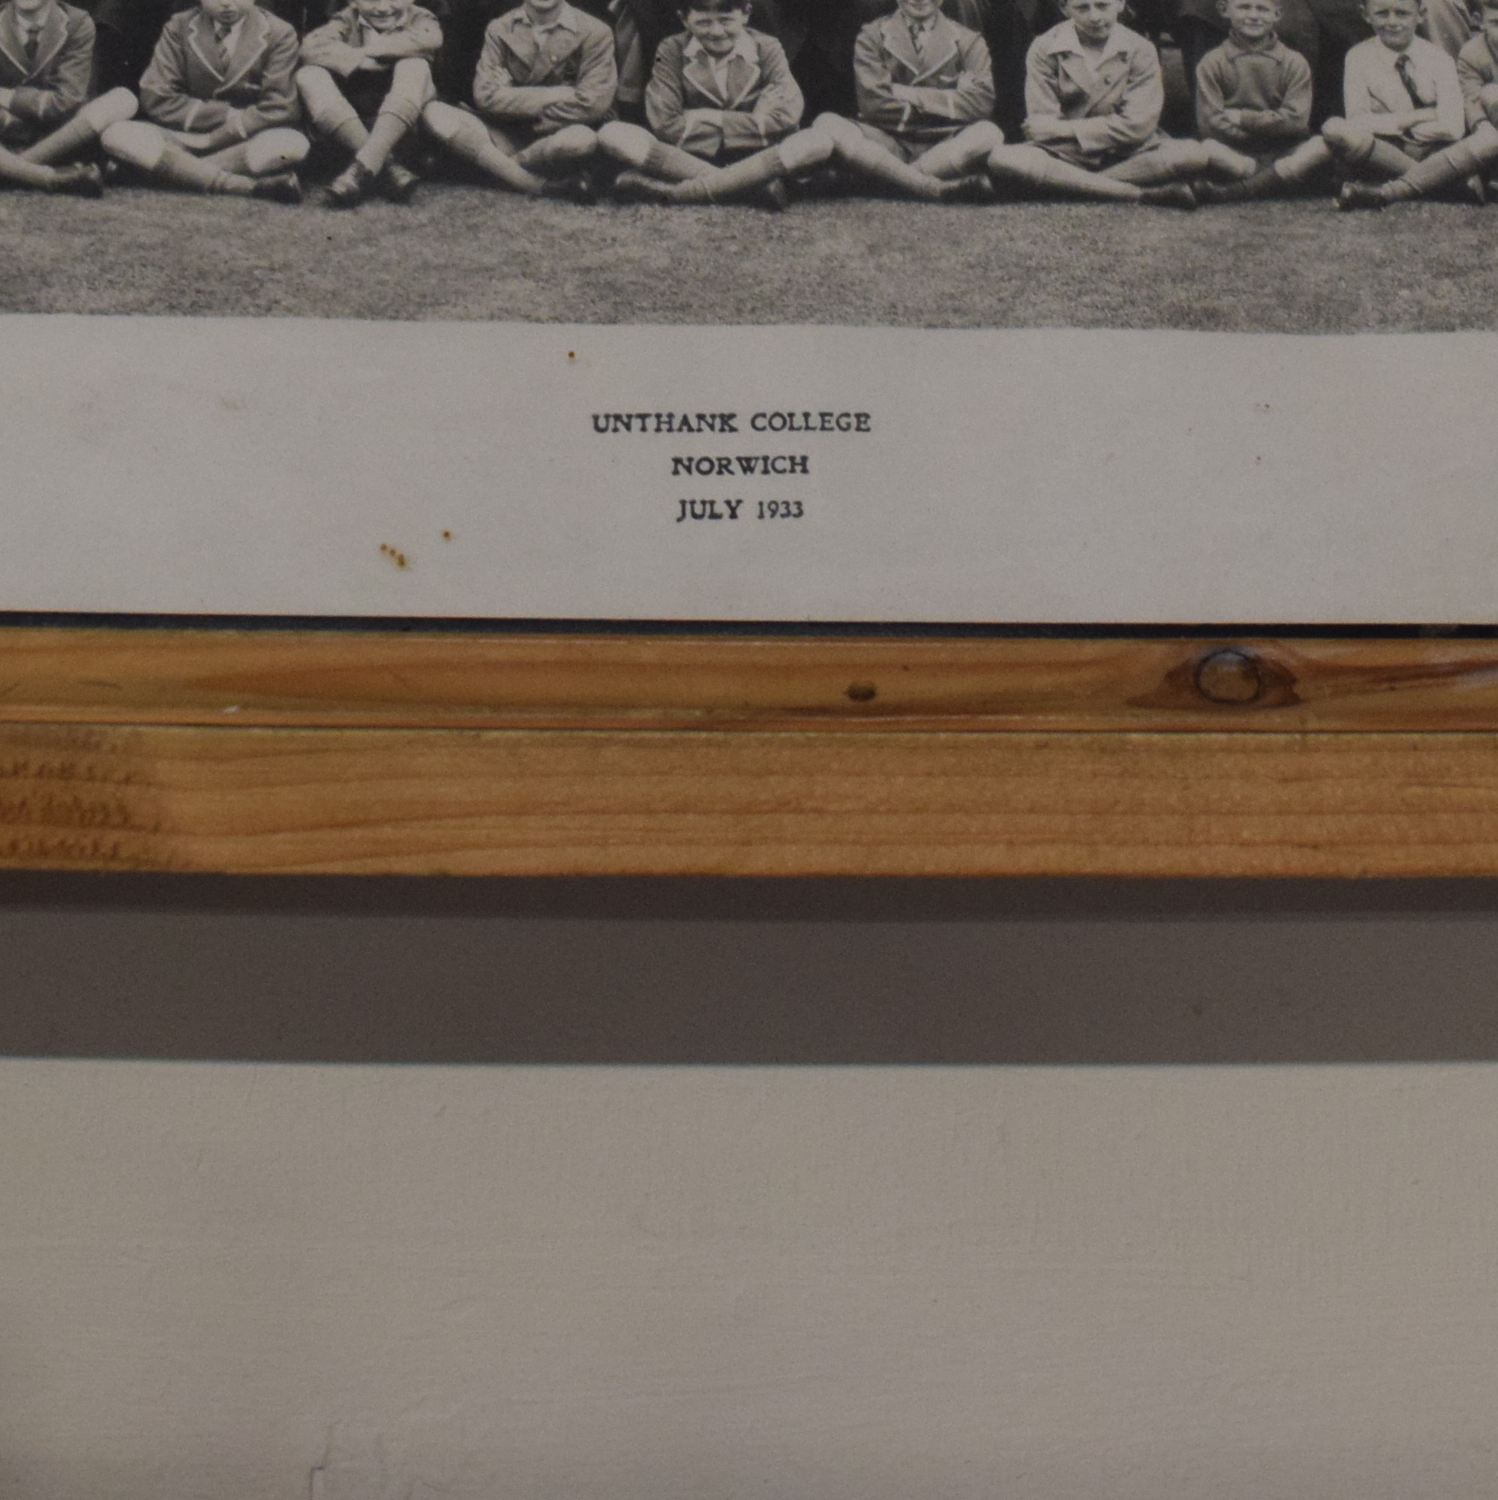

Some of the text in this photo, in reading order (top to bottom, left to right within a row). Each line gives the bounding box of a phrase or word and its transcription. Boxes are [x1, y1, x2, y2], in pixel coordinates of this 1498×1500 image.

[592, 412, 872, 433] UNTHANK COLLEGE
[671, 455, 810, 476] NORWICH
[676, 499, 805, 522] JULY 1933
